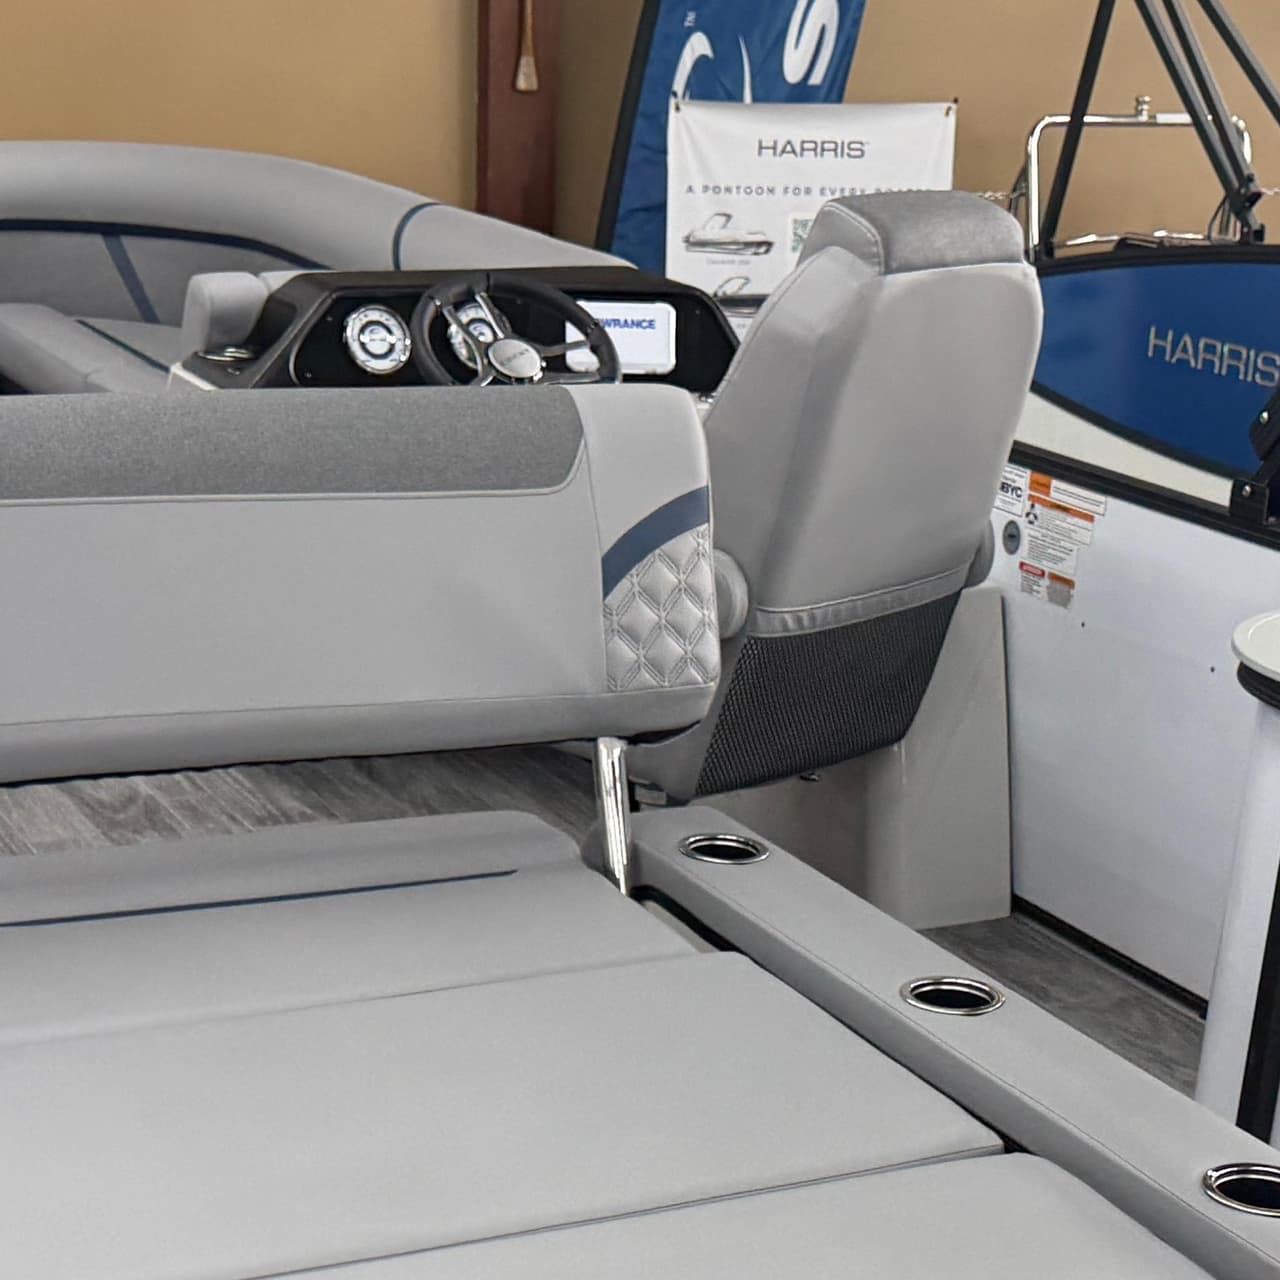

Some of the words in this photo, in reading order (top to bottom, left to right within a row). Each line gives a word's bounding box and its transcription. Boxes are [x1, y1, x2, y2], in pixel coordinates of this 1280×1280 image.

[757, 139, 867, 159] HARRIS
[685, 185, 695, 195] A
[701, 185, 776, 197] PONTOON
[783, 186, 814, 197] FOR
[598, 318, 657, 330] WRANCE
